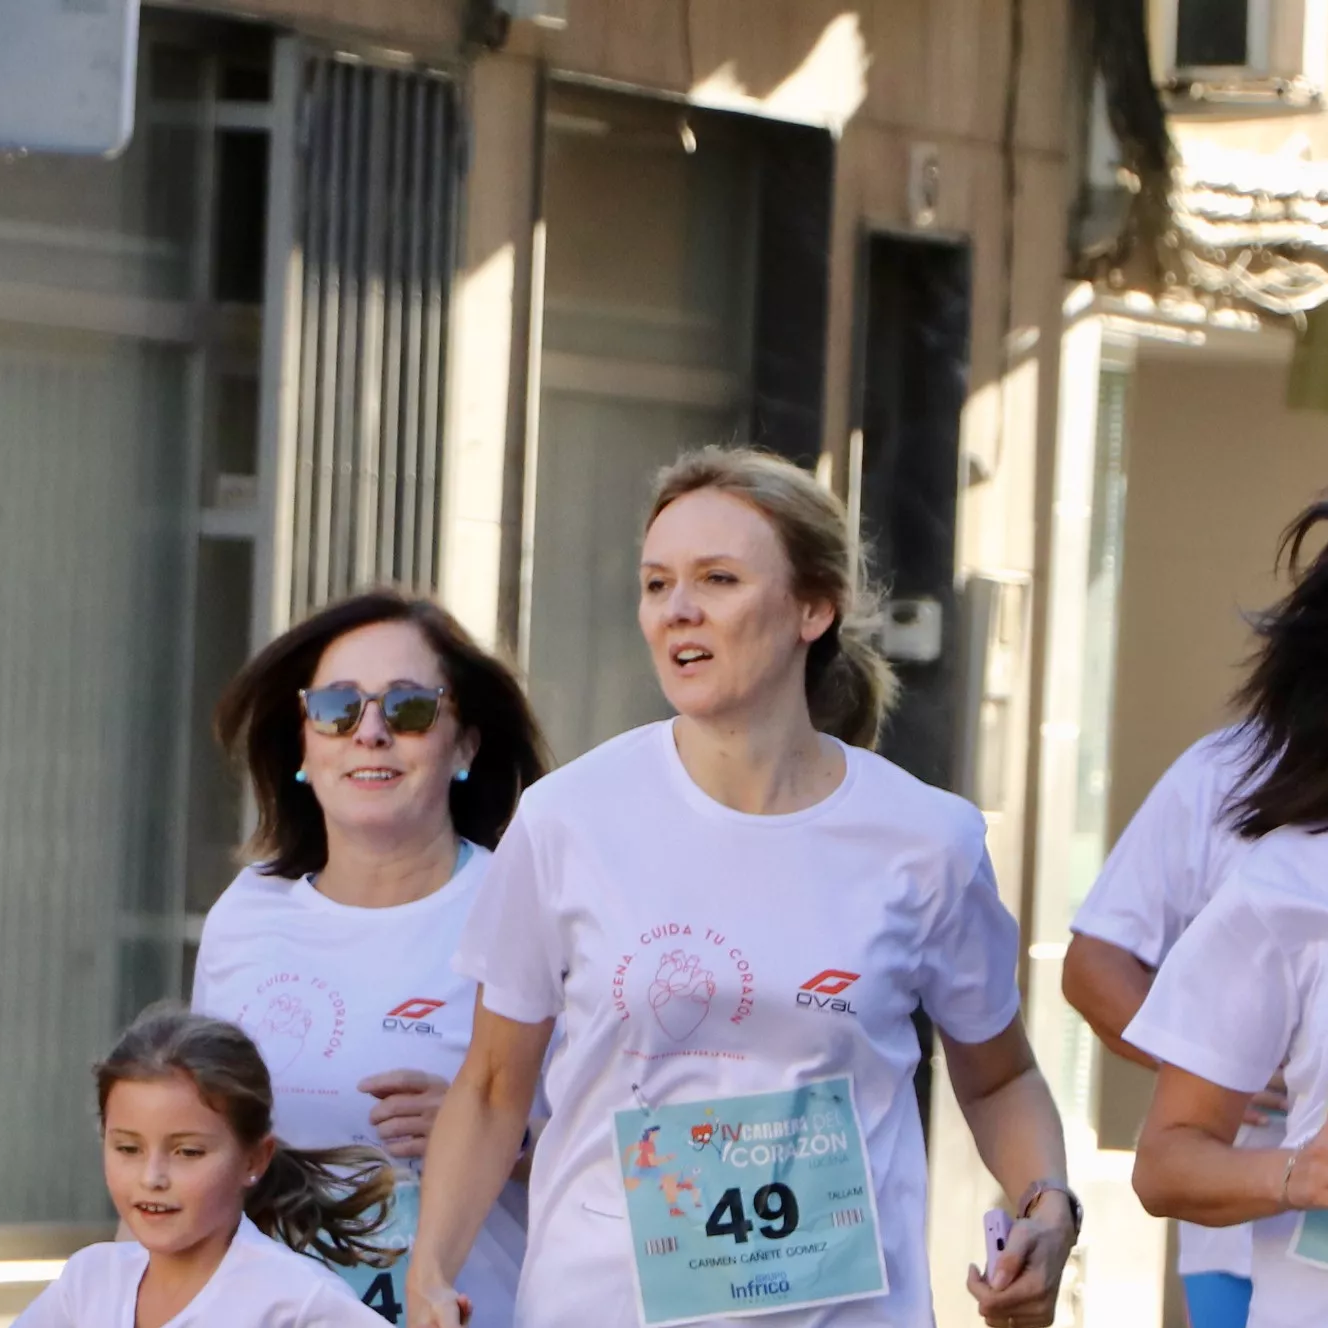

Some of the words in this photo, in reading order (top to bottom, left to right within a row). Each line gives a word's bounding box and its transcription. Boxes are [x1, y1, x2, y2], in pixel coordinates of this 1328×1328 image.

[640, 922, 692, 945] CUIDA
[704, 927, 725, 946] TU
[721, 1121, 743, 1142] IV
[742, 1116, 808, 1142] CARRERA
[705, 1182, 799, 1244] 49
[689, 1255, 737, 1270] CARMEN
[730, 1278, 790, 1299] Infrico
